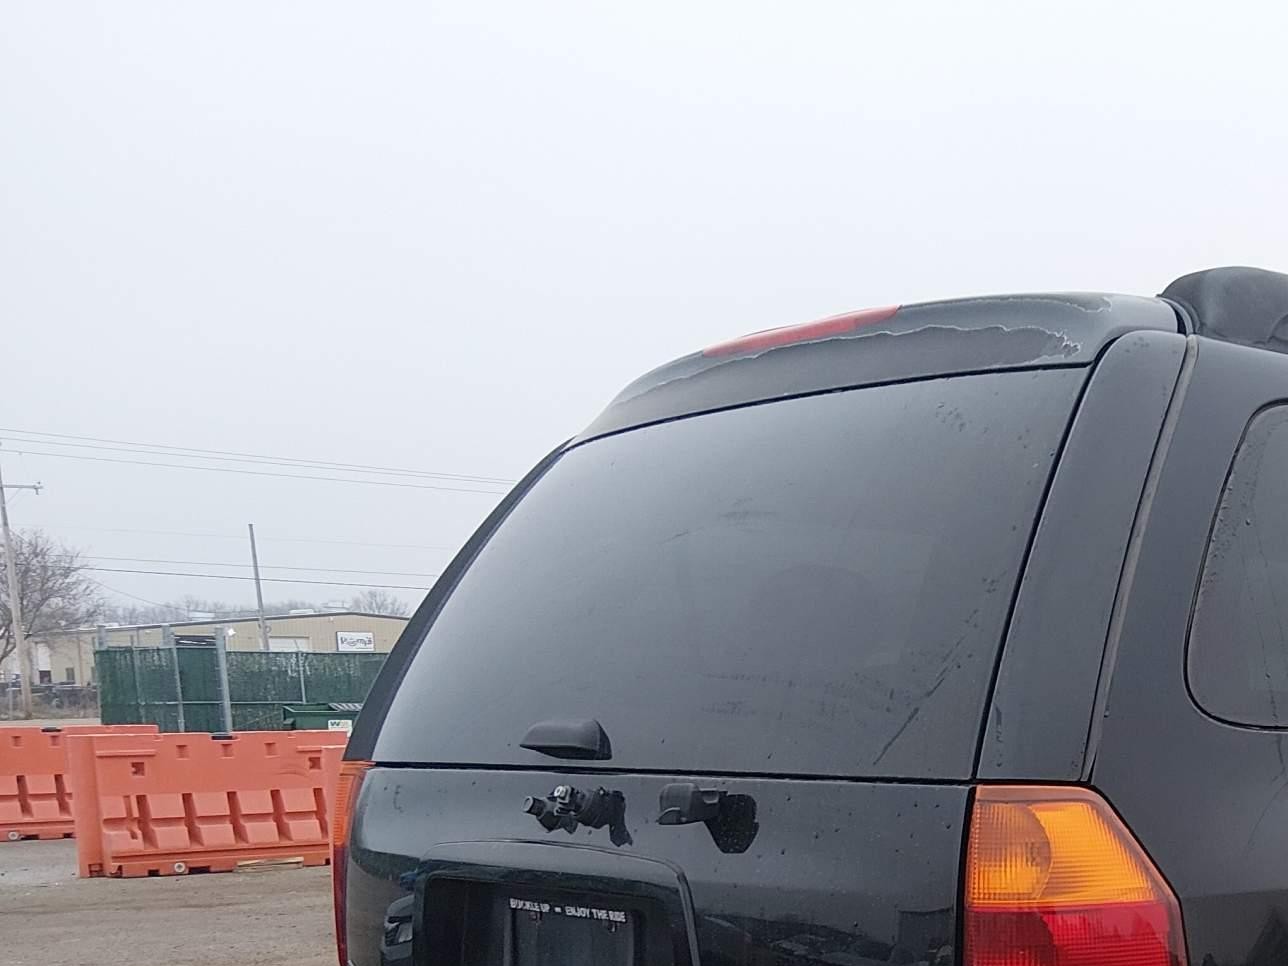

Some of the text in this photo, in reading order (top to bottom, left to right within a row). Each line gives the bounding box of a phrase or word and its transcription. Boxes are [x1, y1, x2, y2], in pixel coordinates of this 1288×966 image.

[510, 898, 540, 912] BUCKLE
[540, 903, 550, 913] UP
[565, 906, 590, 918] ENJOY
[591, 909, 608, 920] THE
[608, 911, 626, 922] RIDE
